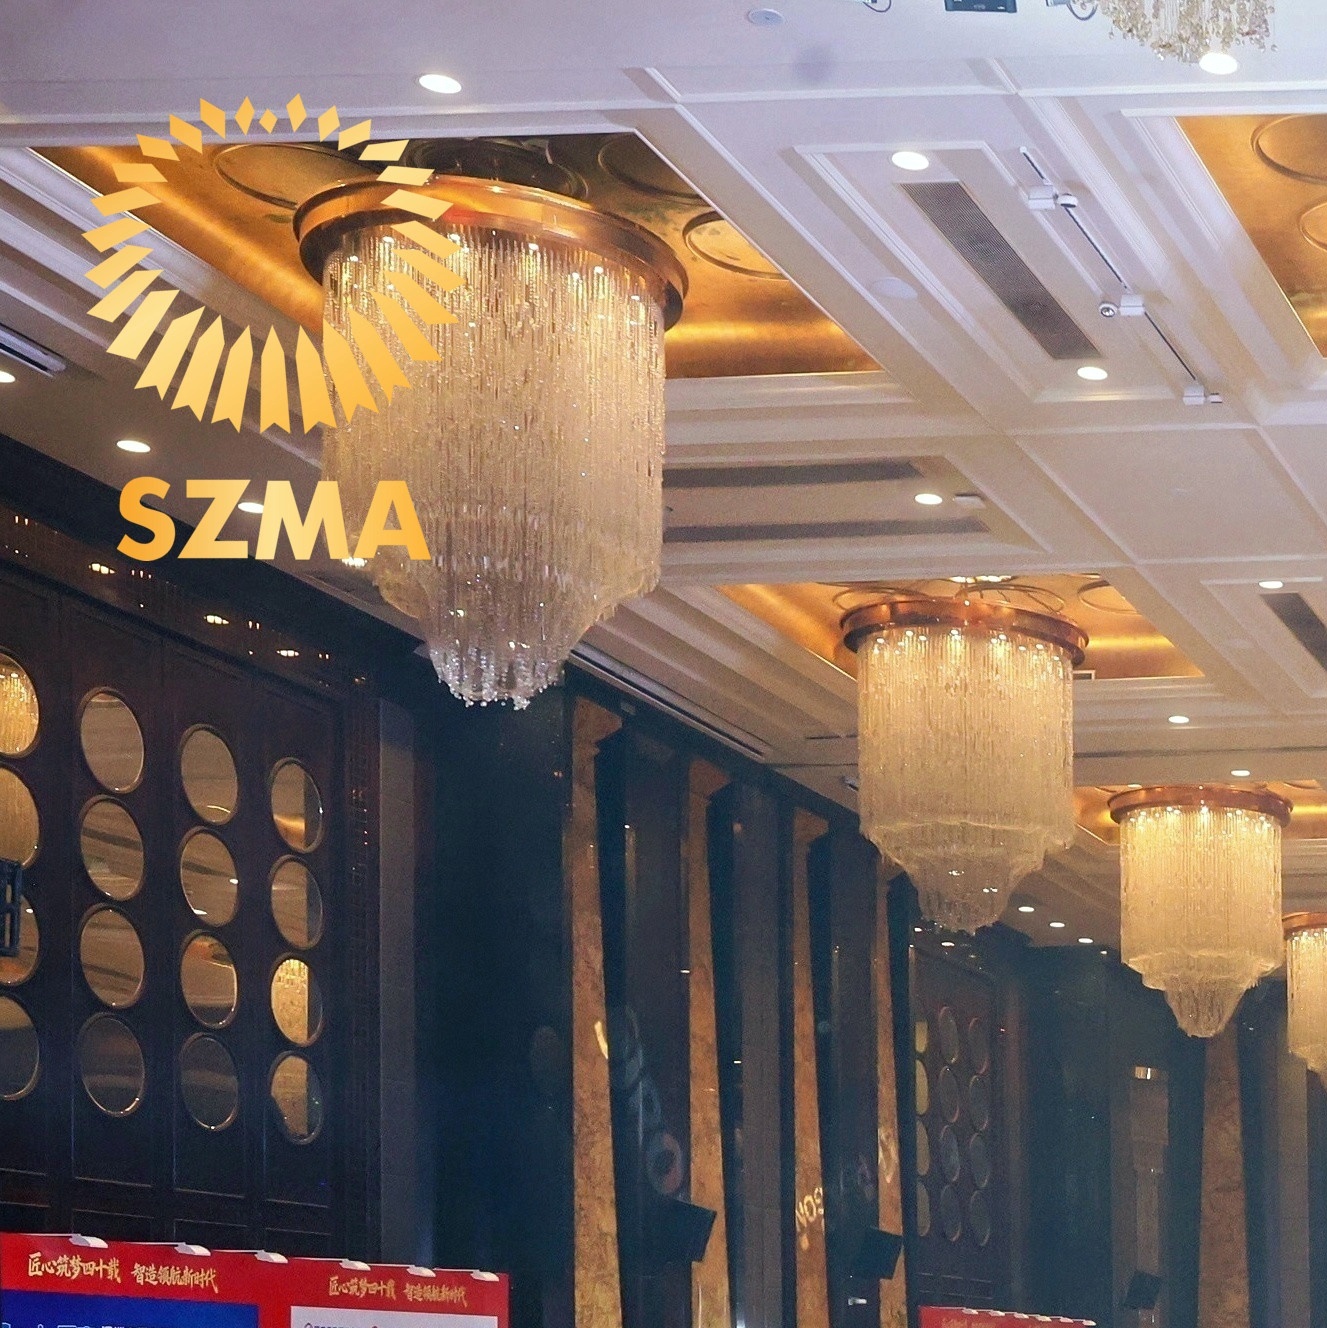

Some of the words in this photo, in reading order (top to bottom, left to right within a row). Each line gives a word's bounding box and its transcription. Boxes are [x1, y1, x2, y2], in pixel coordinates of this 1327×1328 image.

[28, 1252, 122, 1283] 匠心筑梦四十载
[131, 1262, 219, 1293] 智造领航新时代
